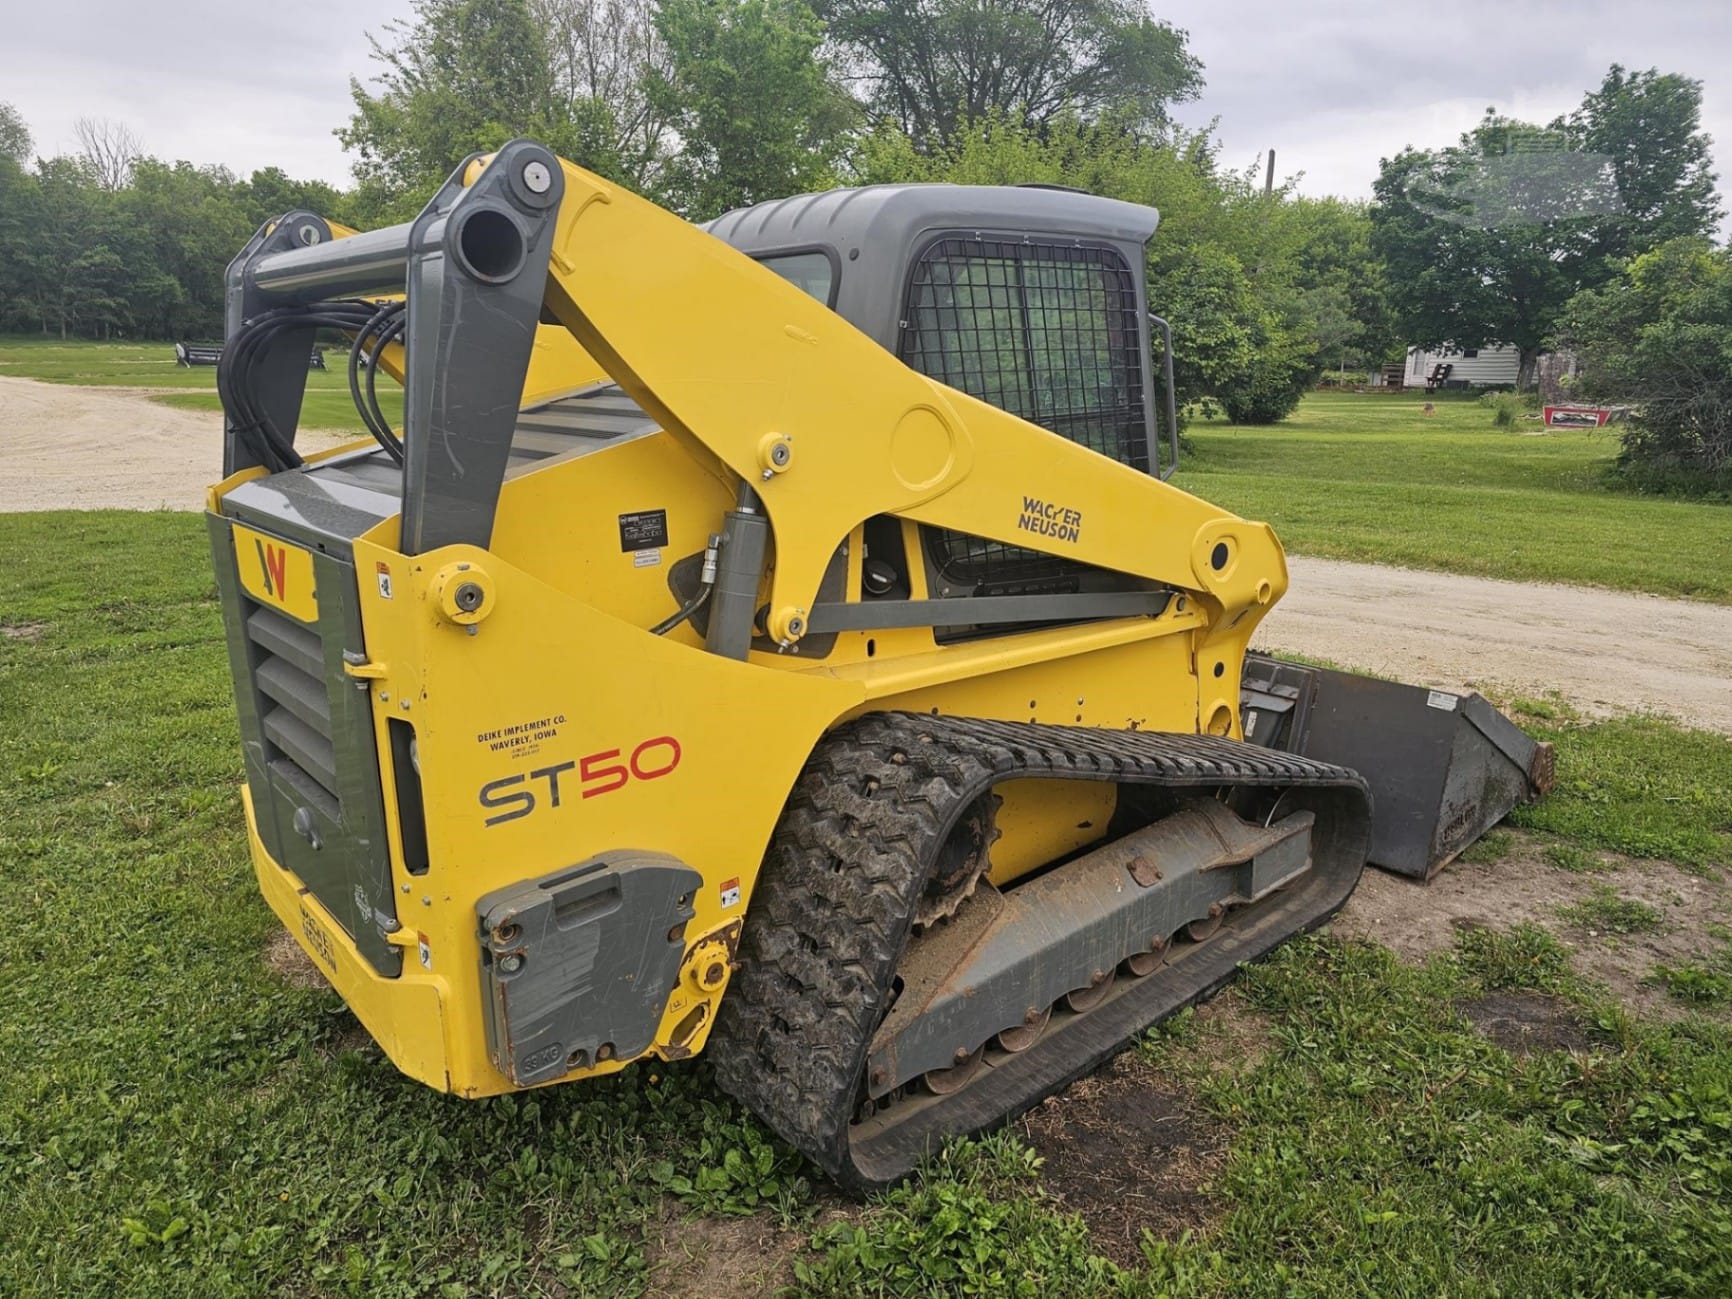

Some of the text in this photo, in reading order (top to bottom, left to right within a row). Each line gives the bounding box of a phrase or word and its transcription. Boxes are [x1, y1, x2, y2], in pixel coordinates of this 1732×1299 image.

[1017, 513, 1079, 543] NEUSON
[477, 715, 567, 743] DEIKE IMPLEMENT CO.
[490, 734, 532, 751] WAVERLY,
[534, 728, 557, 741] IOWA
[479, 735, 682, 828] ST50
